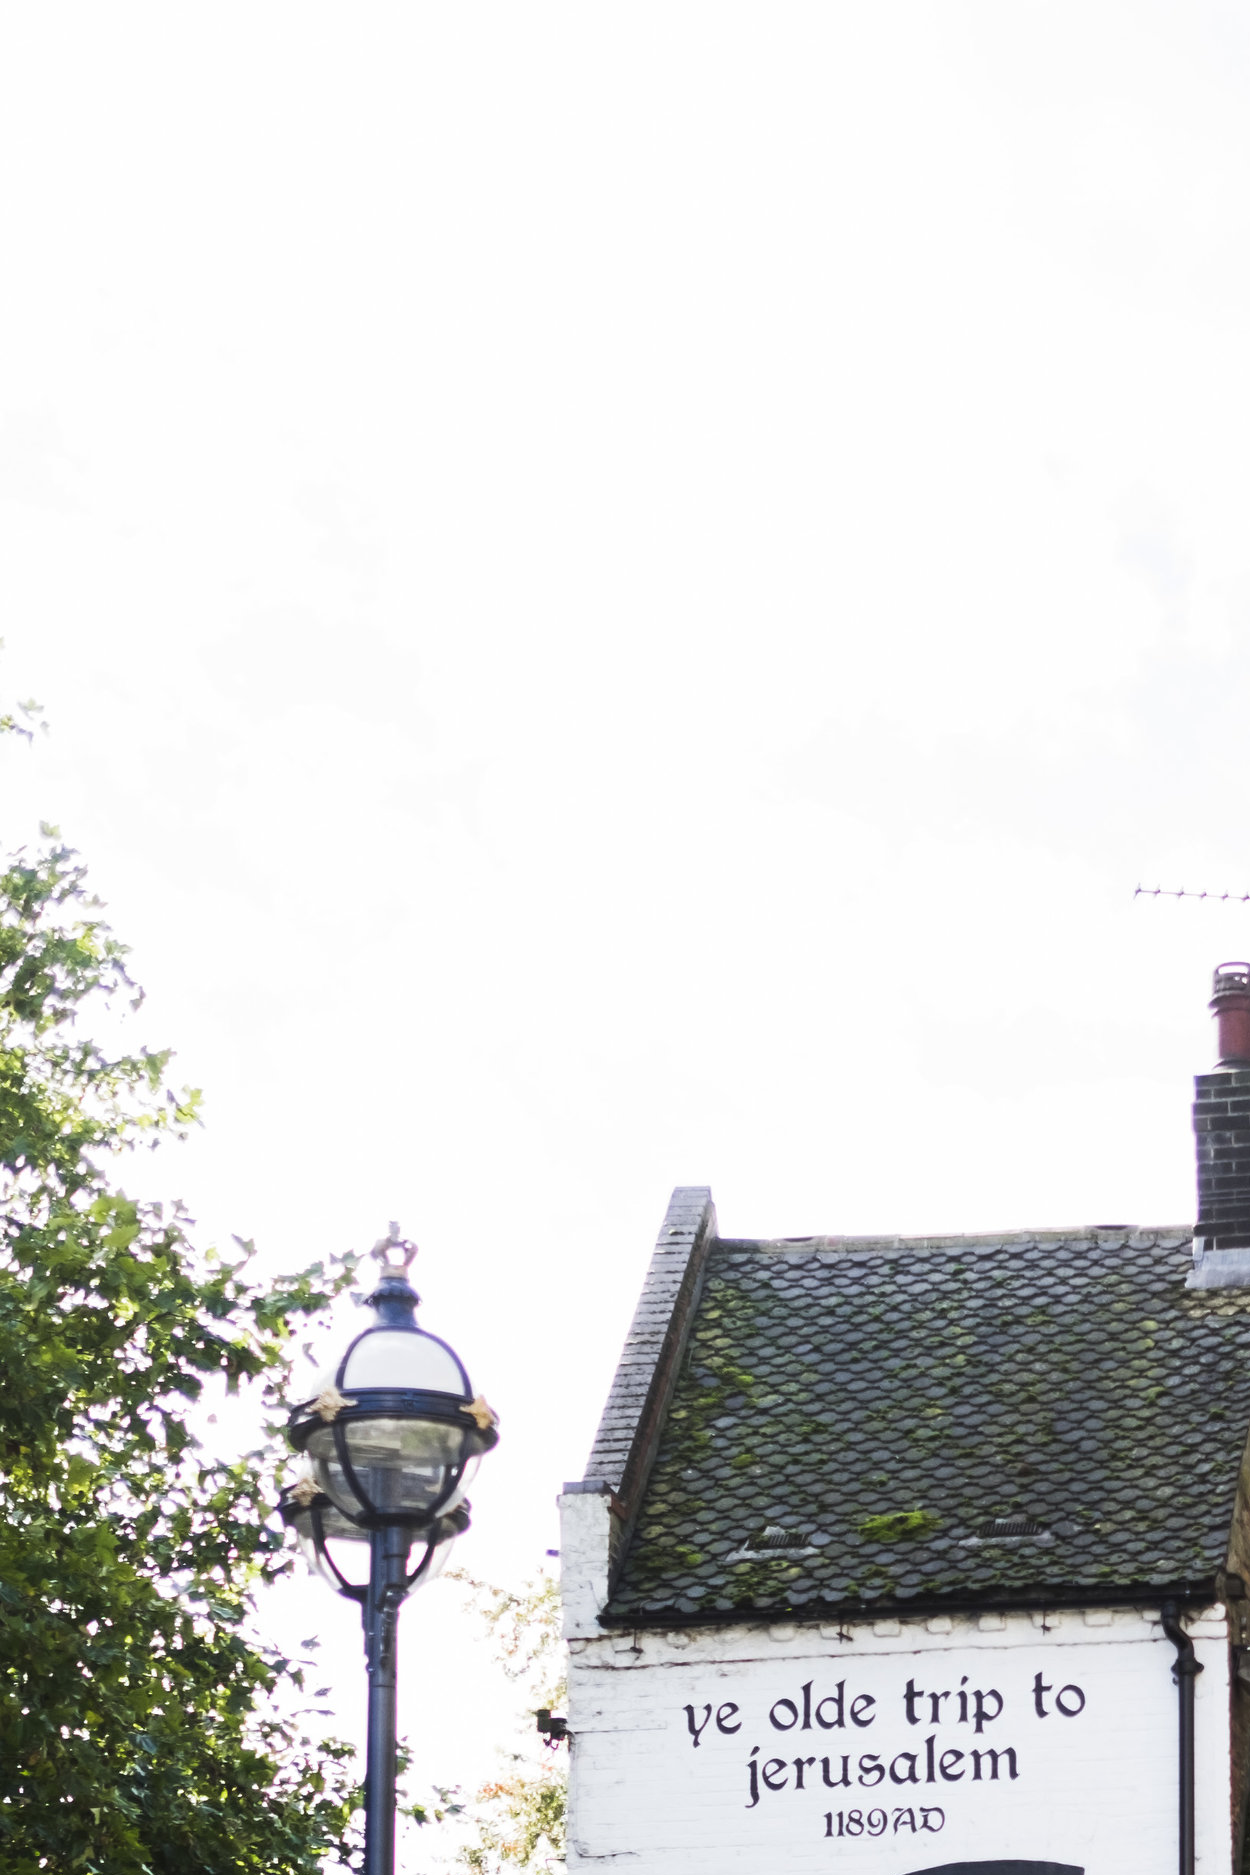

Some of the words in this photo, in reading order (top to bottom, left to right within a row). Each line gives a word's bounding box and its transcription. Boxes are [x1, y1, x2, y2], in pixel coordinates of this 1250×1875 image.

[683, 1701, 743, 1749] ye
[768, 1679, 877, 1732] olde
[902, 1675, 1005, 1734] trip
[1032, 1671, 1087, 1719] to
[745, 1734, 1021, 1809] jerusalem
